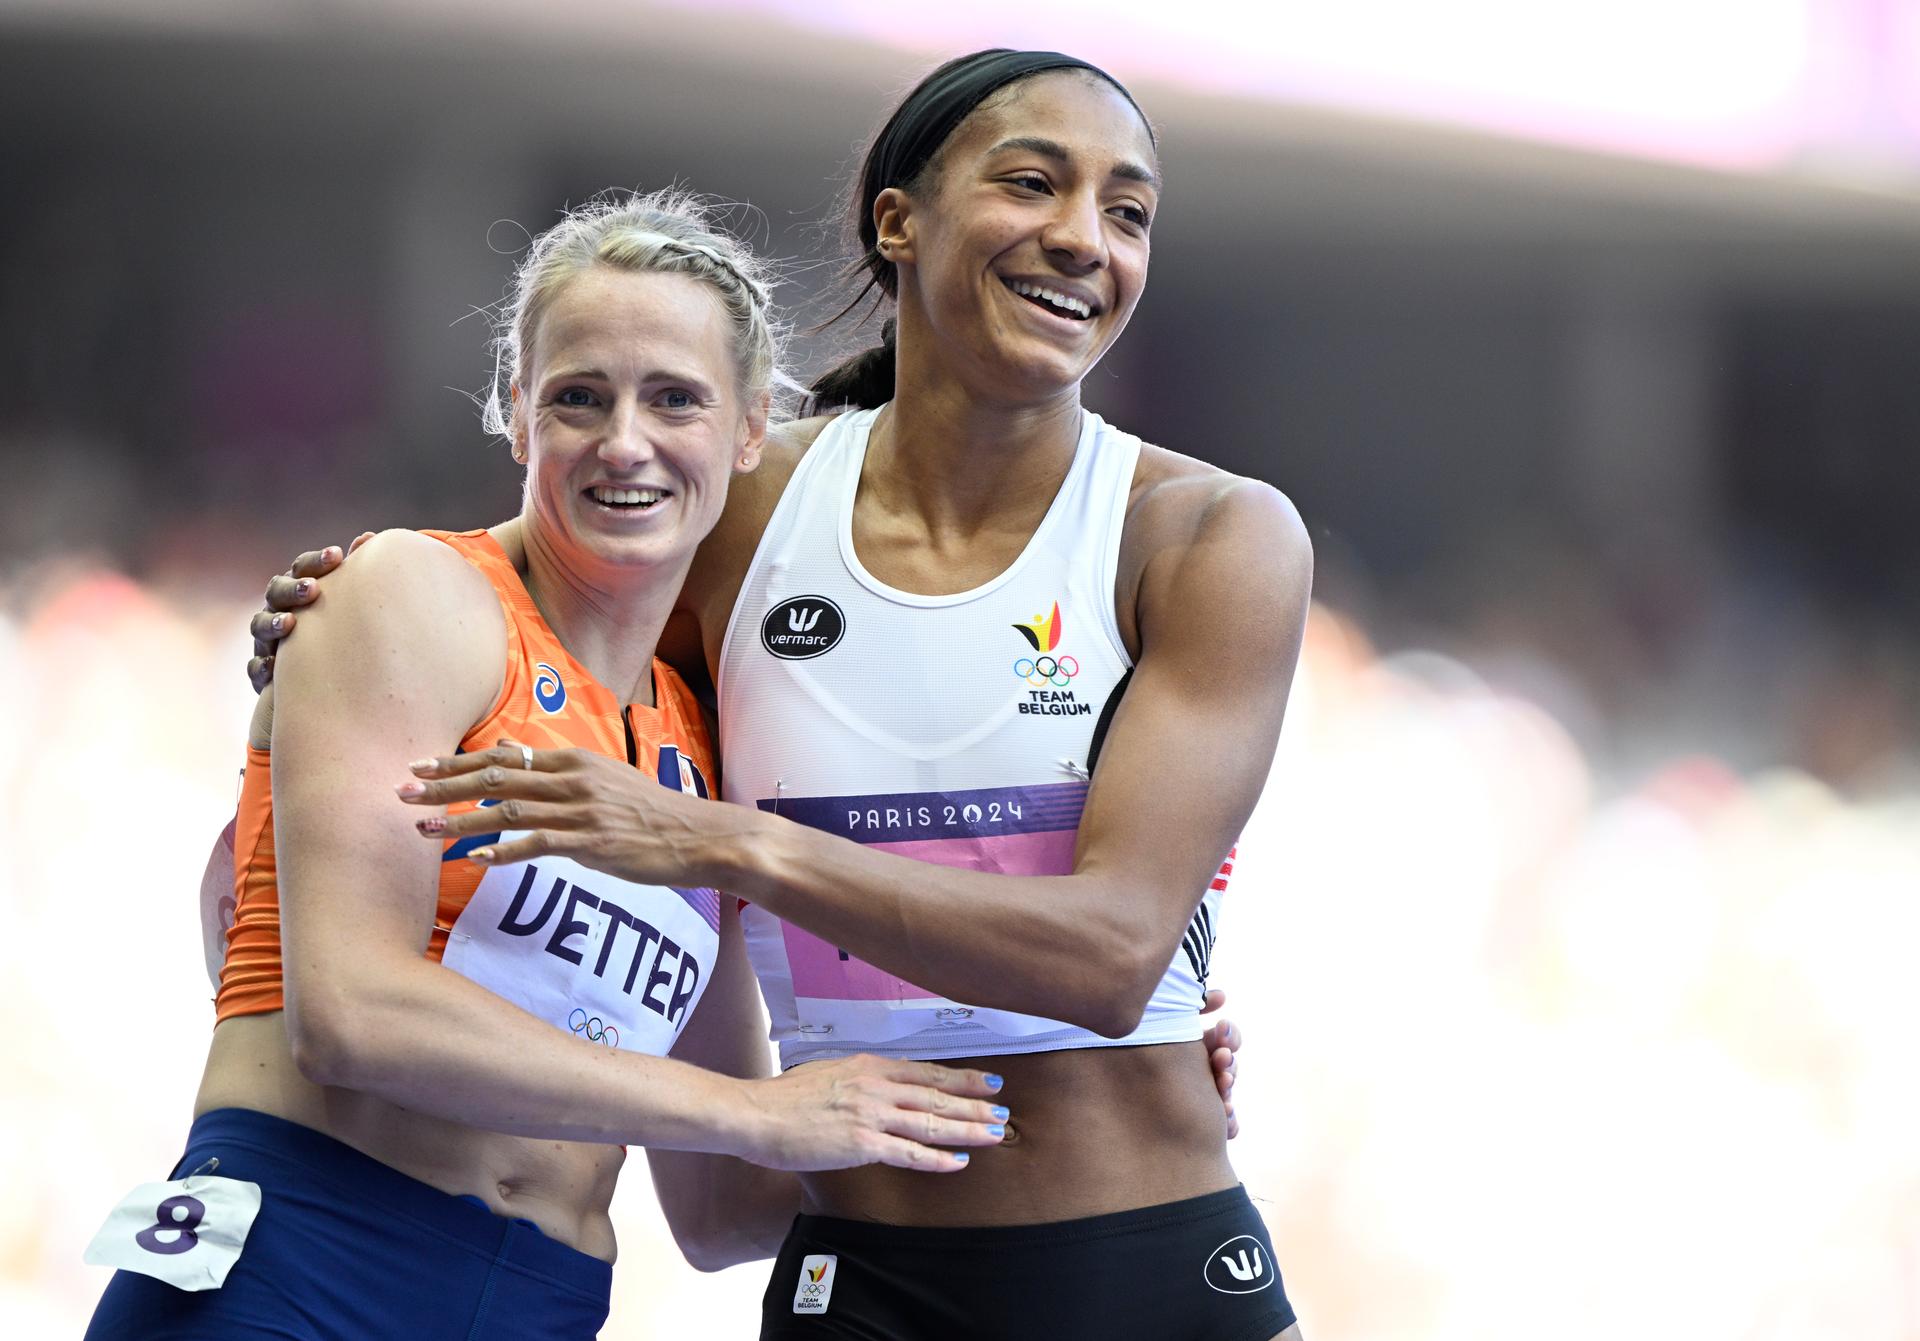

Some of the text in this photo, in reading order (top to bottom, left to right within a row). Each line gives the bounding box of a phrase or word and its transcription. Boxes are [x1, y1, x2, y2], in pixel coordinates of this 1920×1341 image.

[770, 634, 828, 646] vermarc
[1029, 690, 1075, 702] TEAM
[1018, 702, 1091, 716] BELGIUM
[943, 801, 1022, 825] 2024
[497, 863, 700, 1033] VETTER
[135, 1195, 206, 1255] 8
